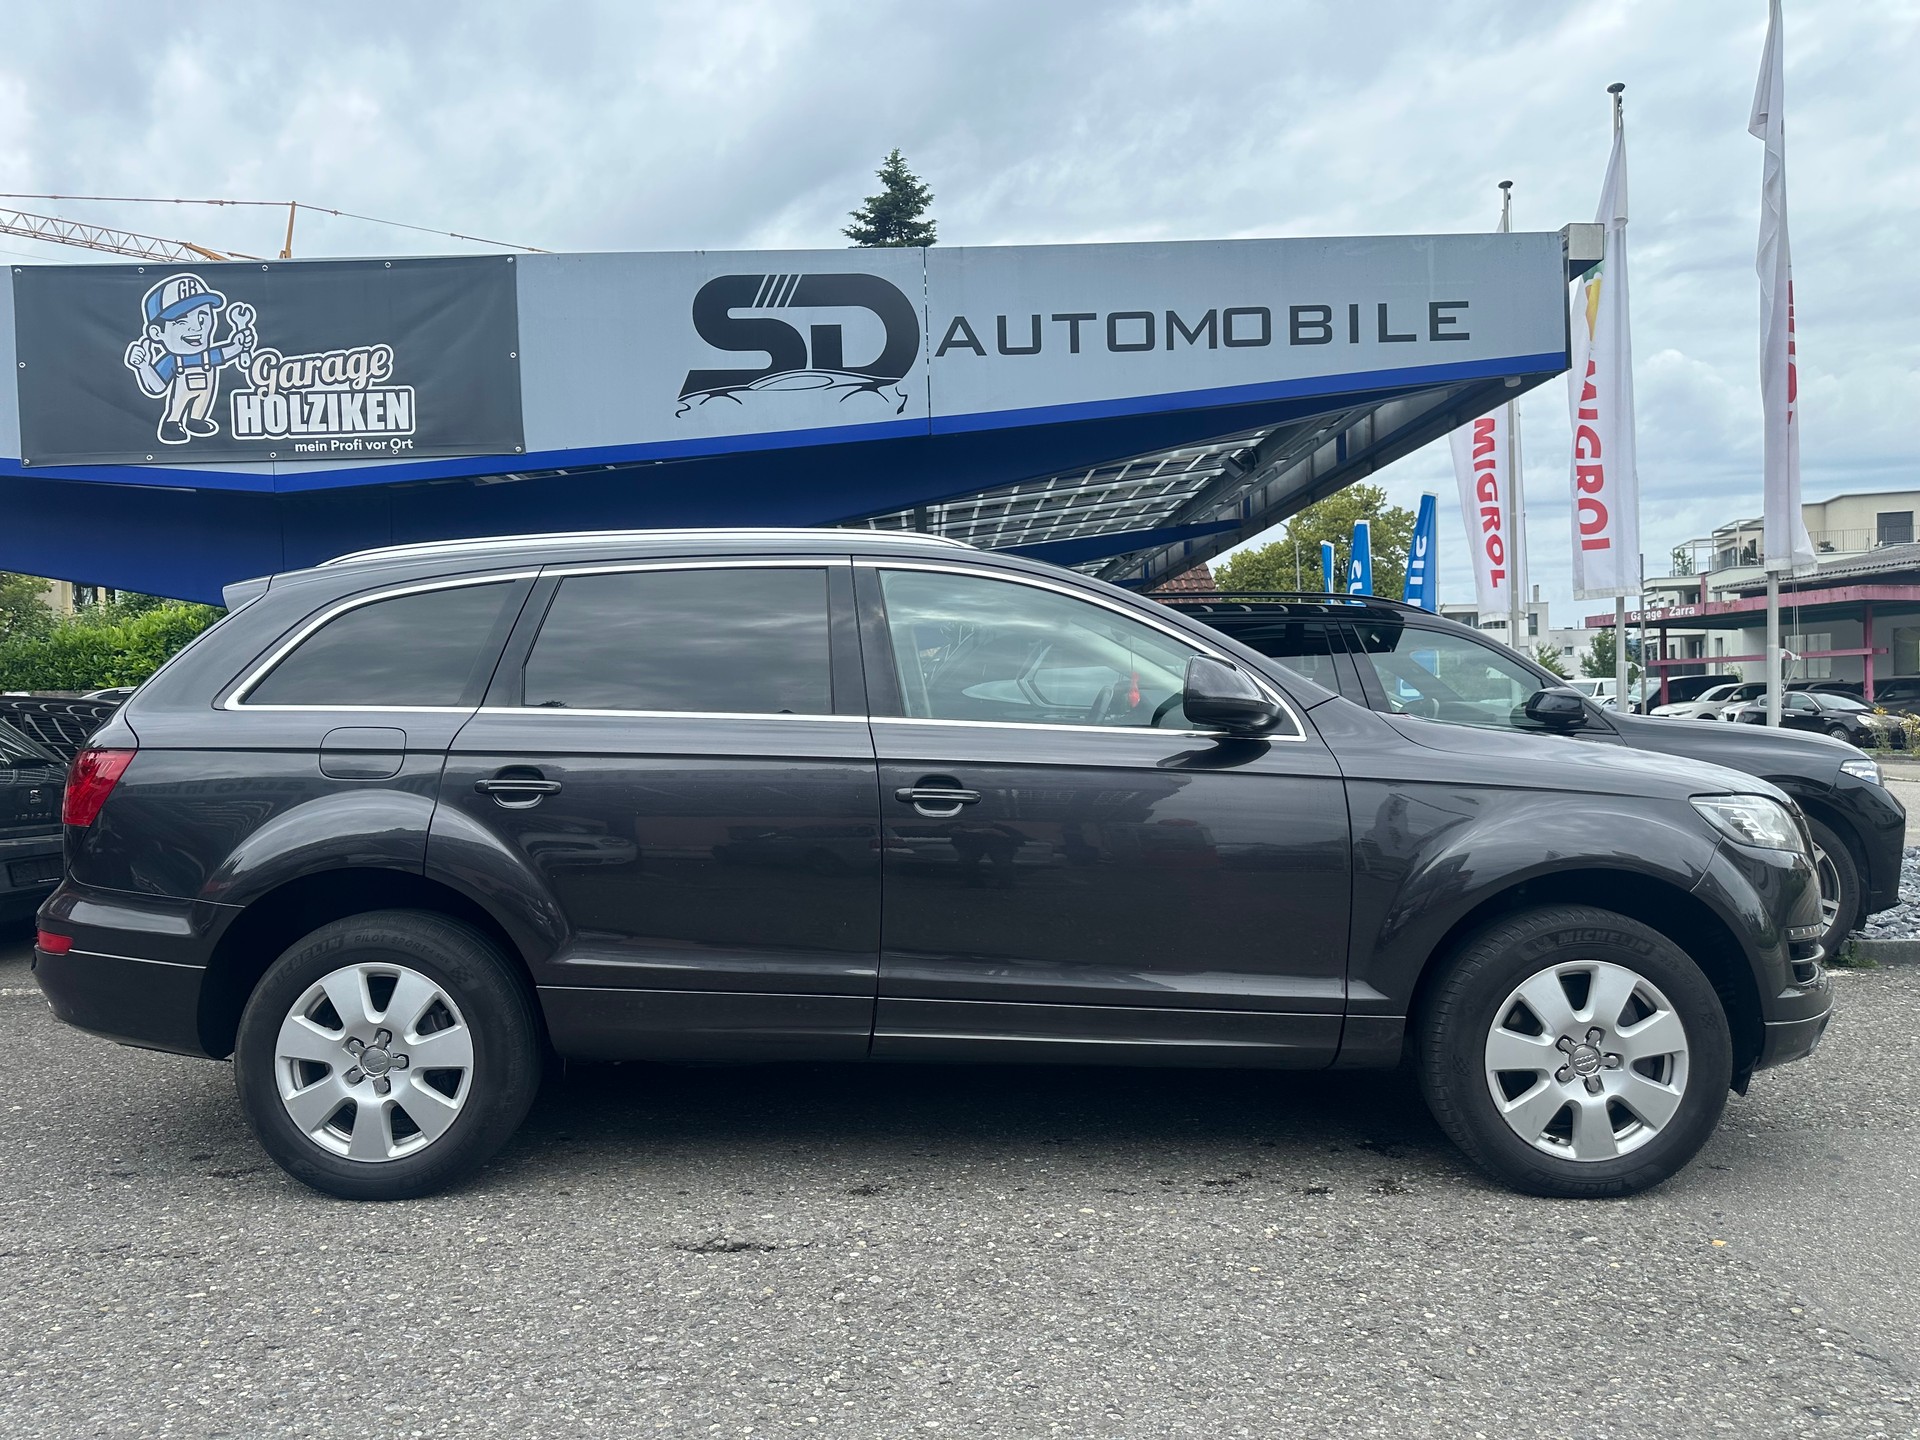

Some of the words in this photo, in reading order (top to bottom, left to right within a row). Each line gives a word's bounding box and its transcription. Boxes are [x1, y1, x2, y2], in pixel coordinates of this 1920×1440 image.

[178, 280, 198, 300] GB
[678, 273, 920, 401] SD
[935, 301, 1472, 358] AUTOMOBILE
[252, 349, 388, 400] Garage
[236, 391, 410, 434] HOLZIKEN
[294, 439, 328, 452] mein
[330, 439, 363, 452] Profi
[365, 440, 388, 451] vor
[389, 438, 414, 450] Ort
[1472, 417, 1506, 588] MIGROL
[1630, 609, 1662, 621] Gaage
[1668, 606, 1695, 617] Zarra
[354, 933, 389, 944] PILOT
[391, 935, 429, 953] SPORT
[1558, 929, 1652, 956] MICHELIN
